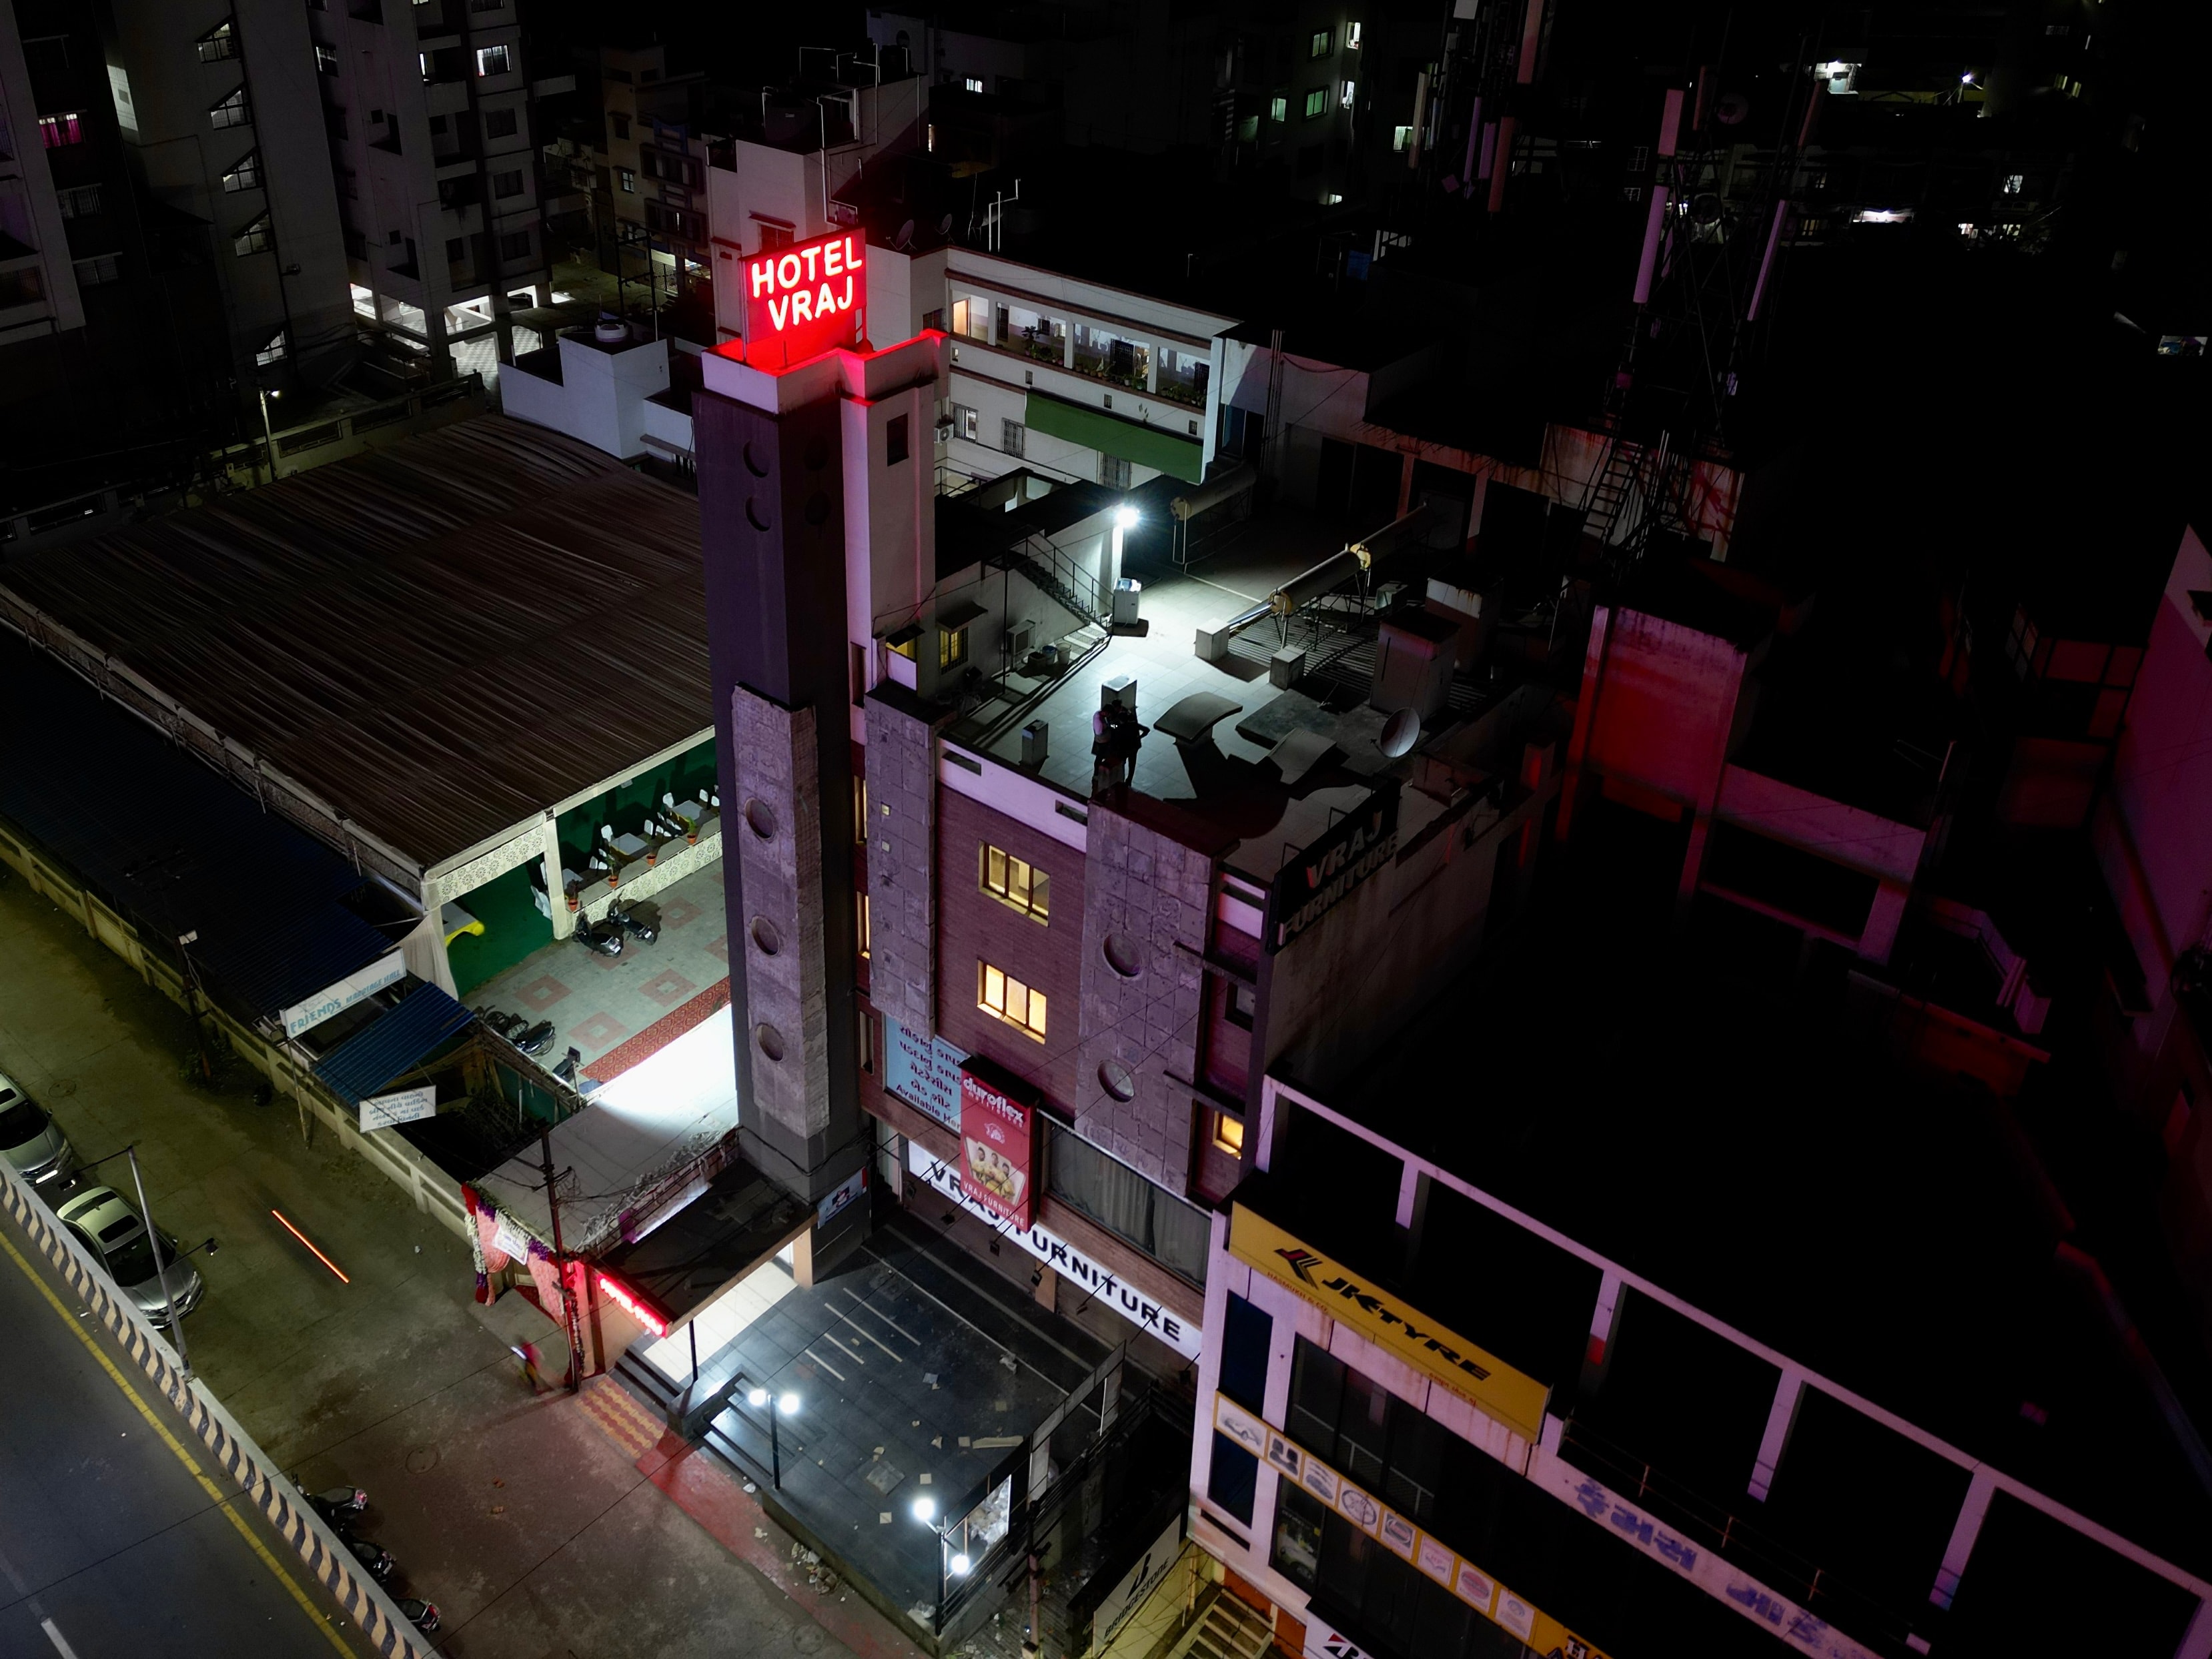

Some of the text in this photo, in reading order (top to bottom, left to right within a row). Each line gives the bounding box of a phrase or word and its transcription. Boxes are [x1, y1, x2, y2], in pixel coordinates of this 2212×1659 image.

[751, 237, 863, 298] HOTEL
[768, 275, 853, 332] VRAJ
[1305, 810, 1382, 890] VRAJ
[1277, 828, 1398, 946] FURNITURE
[290, 998, 342, 1034] FRIENDS
[384, 969, 400, 984] HALL
[897, 1084, 961, 1128] Available Her
[963, 1077, 1024, 1122] duroflex
[963, 1180, 983, 1199] VRAJ
[983, 1194, 1025, 1227] FURNITURE
[1104, 1556, 1170, 1639] BRIDGESTONE
